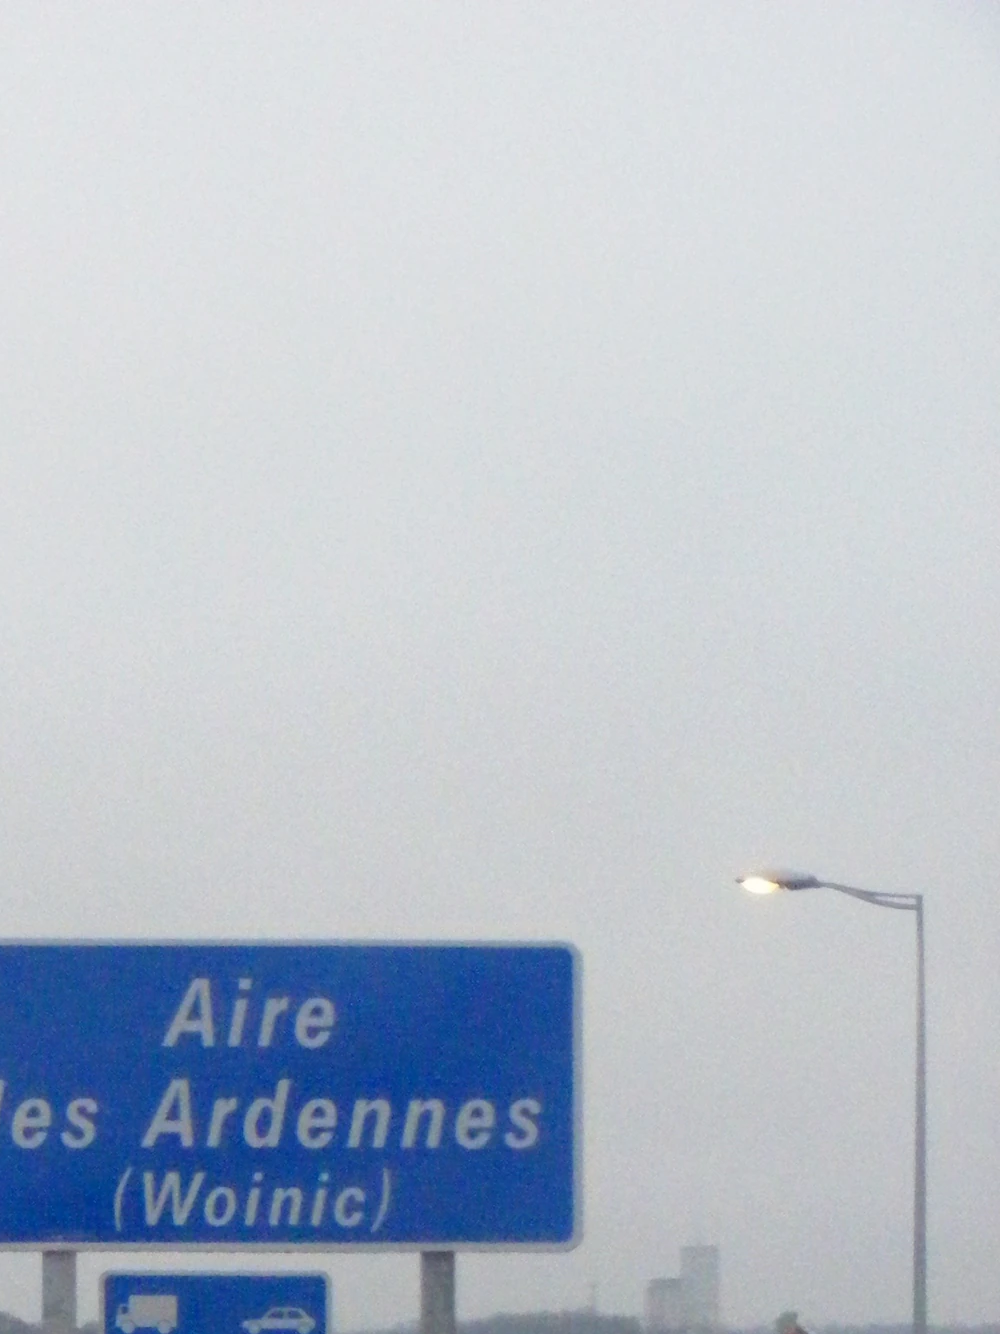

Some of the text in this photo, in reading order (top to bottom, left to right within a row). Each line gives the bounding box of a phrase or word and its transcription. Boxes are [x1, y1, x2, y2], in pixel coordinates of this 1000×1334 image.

[161, 976, 336, 1050] Aire
[140, 1077, 542, 1150] Ardennes
[112, 1166, 393, 1234] (Woinic)
